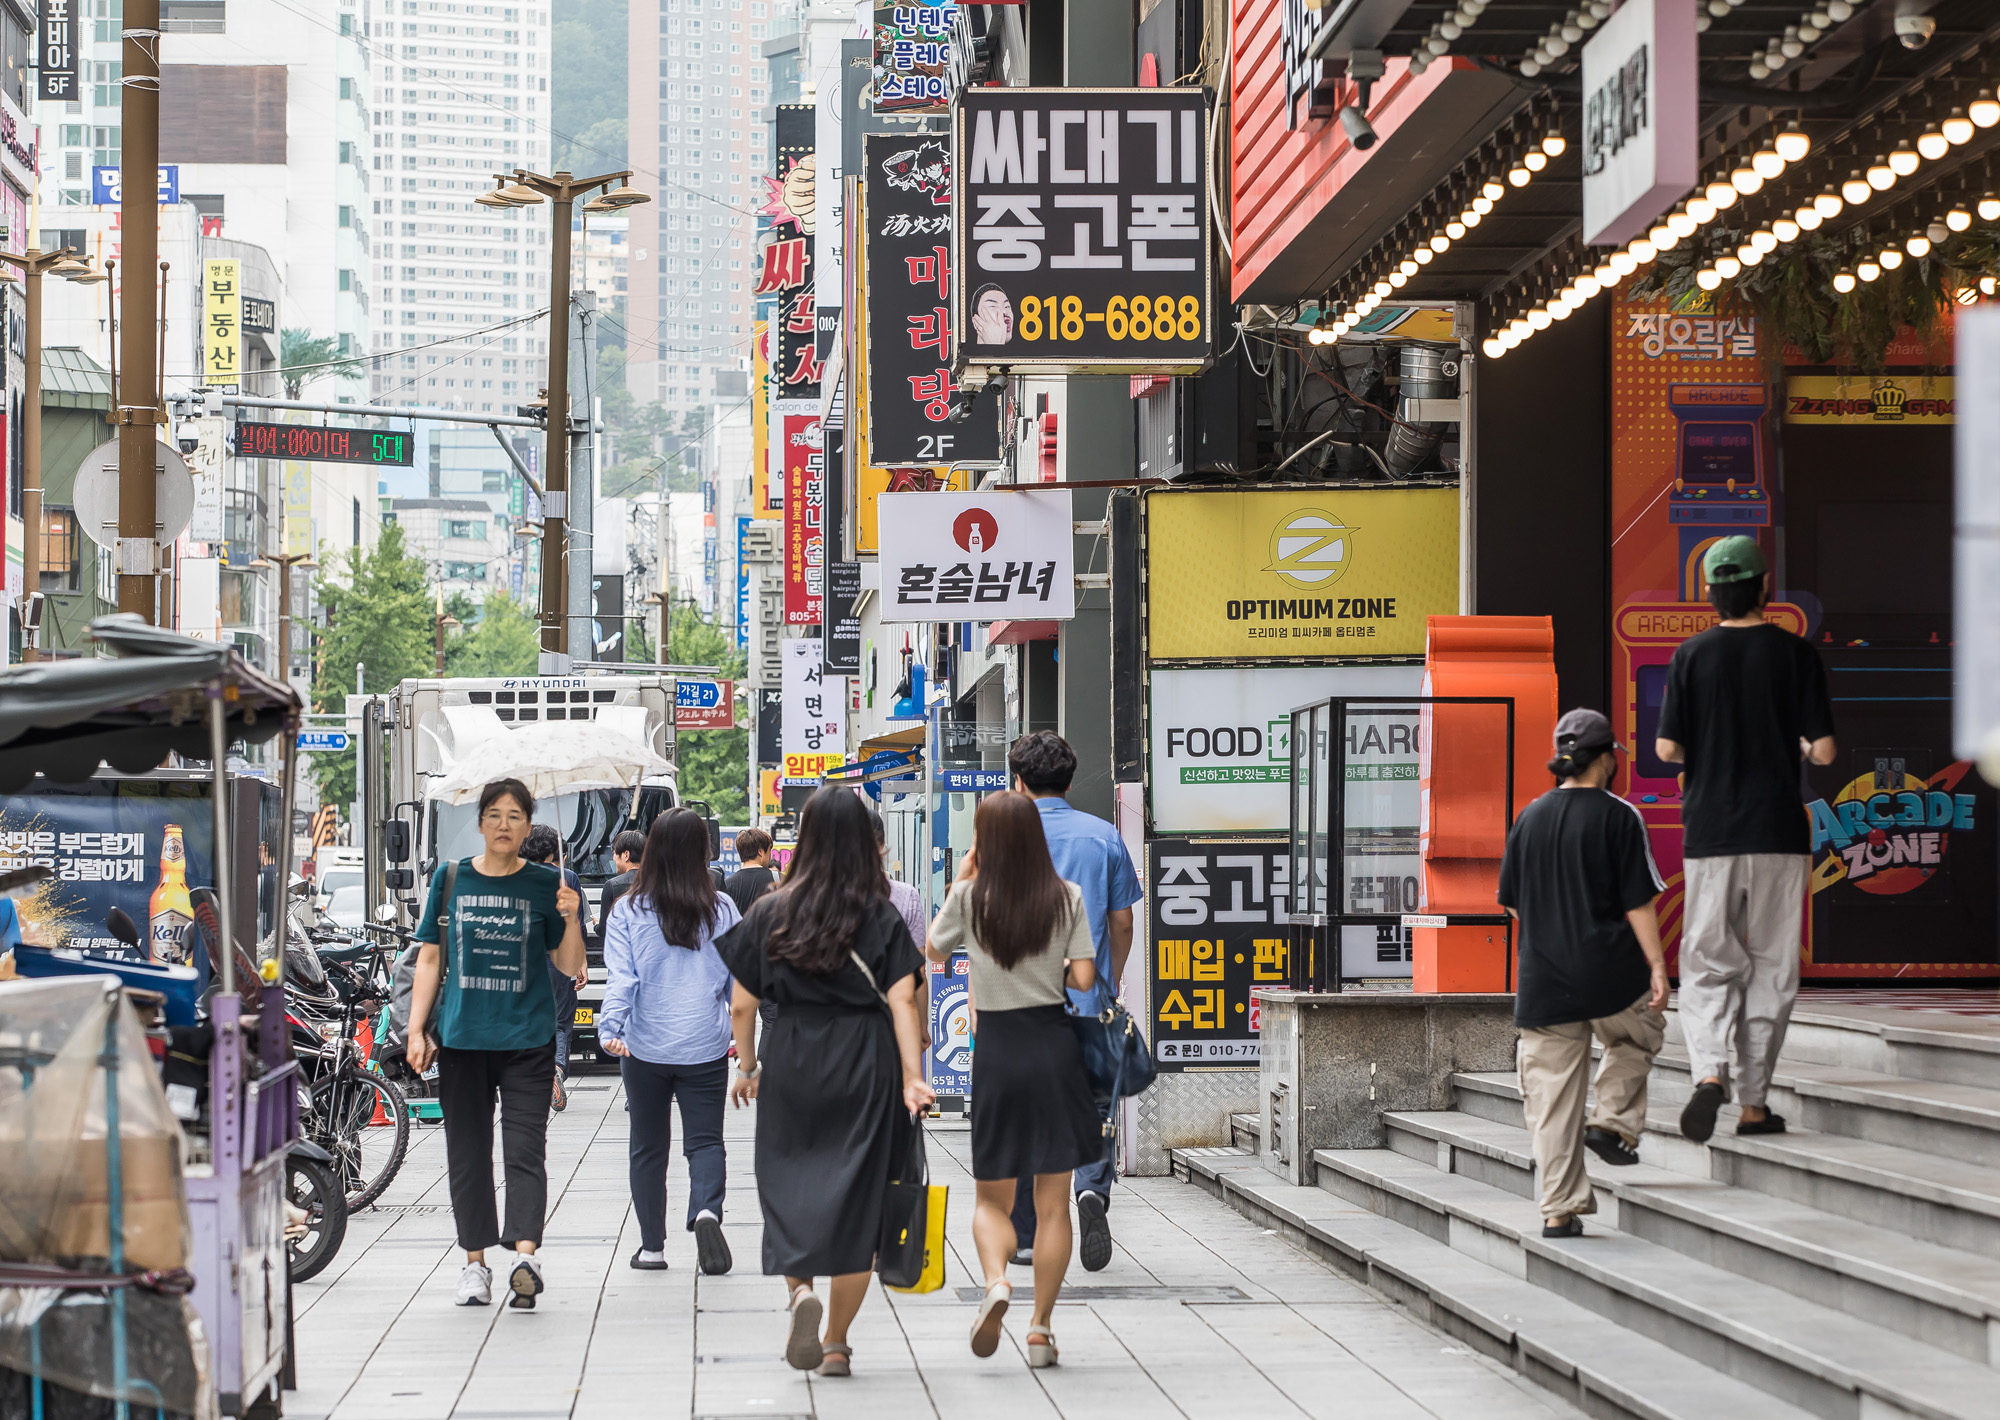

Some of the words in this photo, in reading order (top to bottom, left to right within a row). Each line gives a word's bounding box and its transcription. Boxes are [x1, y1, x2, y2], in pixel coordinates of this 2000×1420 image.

[48, 77, 69, 94] 5F
[970, 110, 1196, 183] 싸대기
[973, 195, 1199, 271] 중고폰
[210, 281, 235, 370] 부동산
[1019, 295, 1200, 341] 818-6888
[905, 246, 960, 421] 마라탕
[1627, 313, 1757, 360] 짱오락실
[772, 402, 801, 411] salon
[804, 401, 819, 411] de
[1688, 388, 1750, 402] ARCADE
[372, 434, 403, 463] 5대
[916, 435, 955, 458] 2F
[897, 561, 1056, 604] 혼술남녀
[1227, 598, 1331, 621] OPTIMUM
[1338, 598, 1396, 619] ZONE
[1248, 627, 1288, 639] 프리미엄
[1292, 626, 1332, 638] 피씨카페
[1336, 626, 1376, 638] 옵티멈존
[522, 680, 587, 688] HYUNDAI
[703, 689, 713, 699] 21
[702, 710, 727, 718] ホテル
[804, 663, 825, 749] 서면당
[1167, 727, 1262, 758] FOOD
[787, 756, 825, 776] 임대
[1184, 770, 1229, 783] 신선하고
[1232, 769, 1266, 782] 맛있는
[950, 774, 972, 787] 편히
[1806, 792, 1976, 852] ARCADE
[59, 832, 144, 856] 부드럽게
[1842, 832, 1941, 880] ZONE
[59, 857, 144, 882] 강렬하게
[1158, 939, 1224, 981] 매입
[936, 983, 964, 999] TENNIS
[1159, 988, 1225, 1030] 수리
[954, 1016, 970, 1036] 2
[1182, 1044, 1202, 1058] 문의
